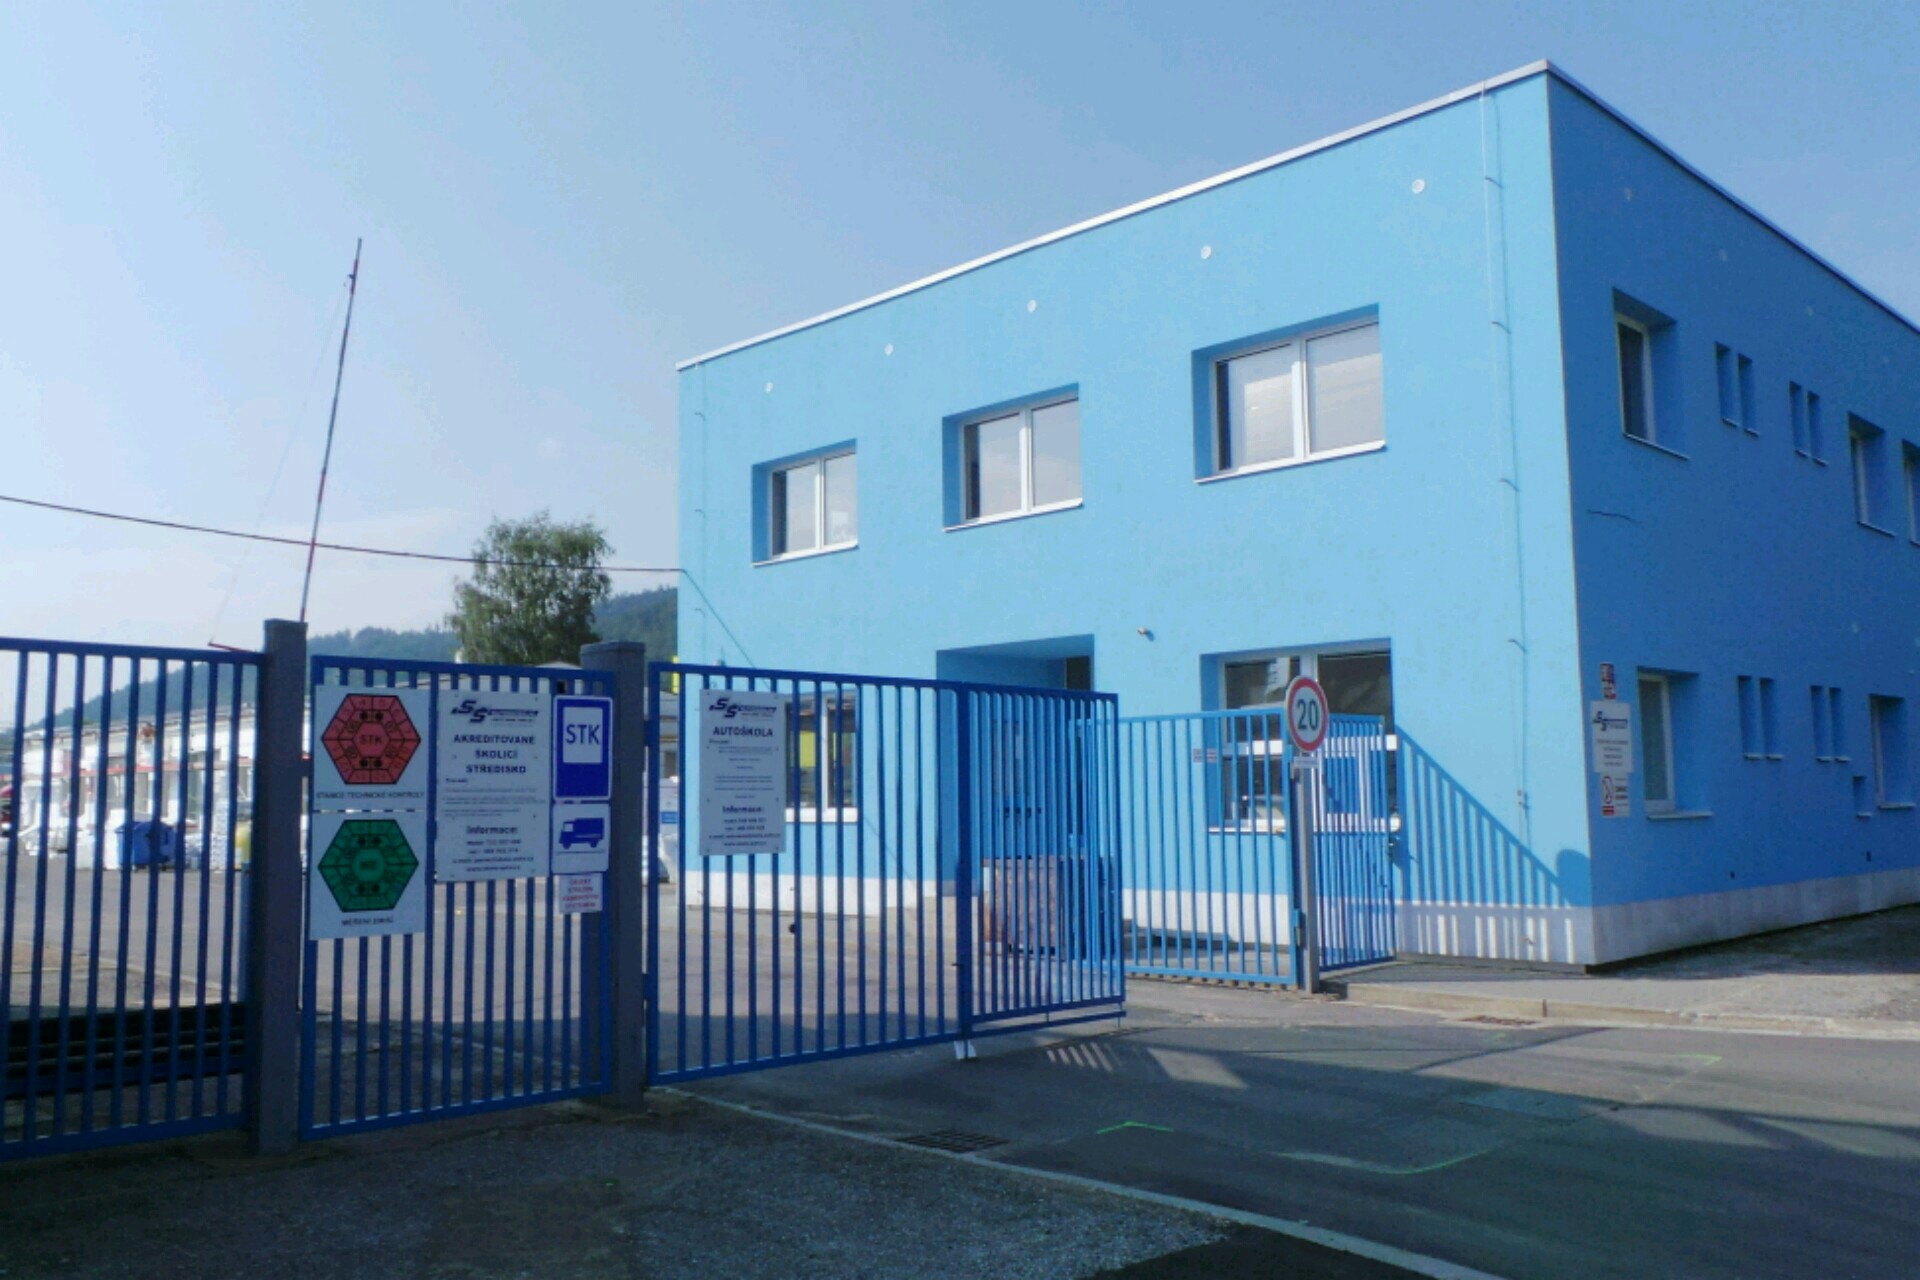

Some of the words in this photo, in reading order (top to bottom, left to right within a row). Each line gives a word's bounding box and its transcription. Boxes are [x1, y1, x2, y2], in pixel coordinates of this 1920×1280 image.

[1297, 698, 1319, 731] 20
[565, 724, 600, 745] STK
[712, 725, 774, 738] AUTOŠKOLA
